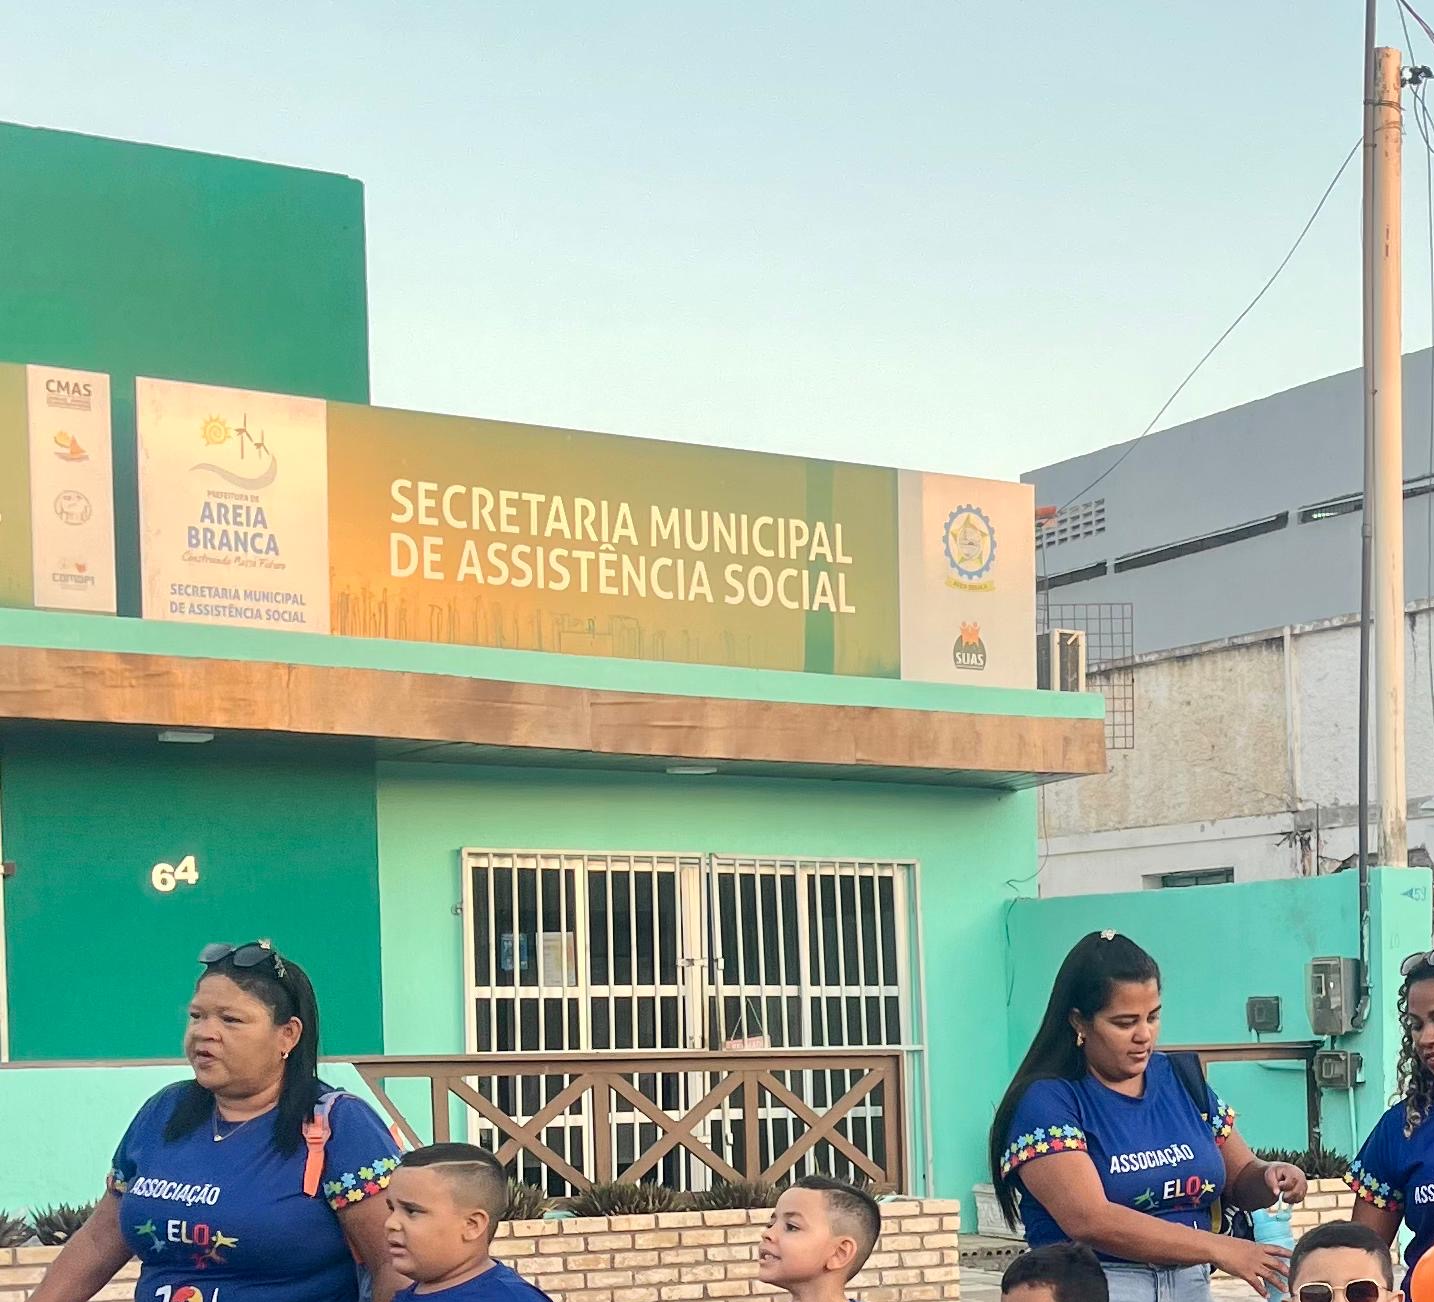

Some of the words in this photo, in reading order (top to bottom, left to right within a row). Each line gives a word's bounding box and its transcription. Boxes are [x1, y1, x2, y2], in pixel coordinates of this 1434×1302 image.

[46, 379, 92, 397] CMAS
[200, 501, 268, 529] AREIA
[389, 478, 638, 546] SECRETARIA
[649, 504, 853, 566] MUNICIPAL
[187, 526, 280, 556] BRANCA
[388, 532, 445, 581] DE
[456, 542, 714, 605] ASSISTÊNCIA
[723, 562, 857, 615] SOCIAL
[170, 583, 241, 601] SECRETARIA
[243, 589, 307, 606] MUNICIPAL
[169, 600, 186, 614] DE
[188, 602, 262, 621] ASSISTÊNCIA
[265, 608, 307, 624] SOCIAL
[956, 652, 984, 666] SUAS
[151, 855, 199, 892] 64
[1109, 1143, 1195, 1174] ASSOCIAÇÃO
[130, 1176, 221, 1207] ASSOCIAÇÃO
[1163, 1175, 1201, 1200] ELO
[167, 1219, 210, 1246] ELO
